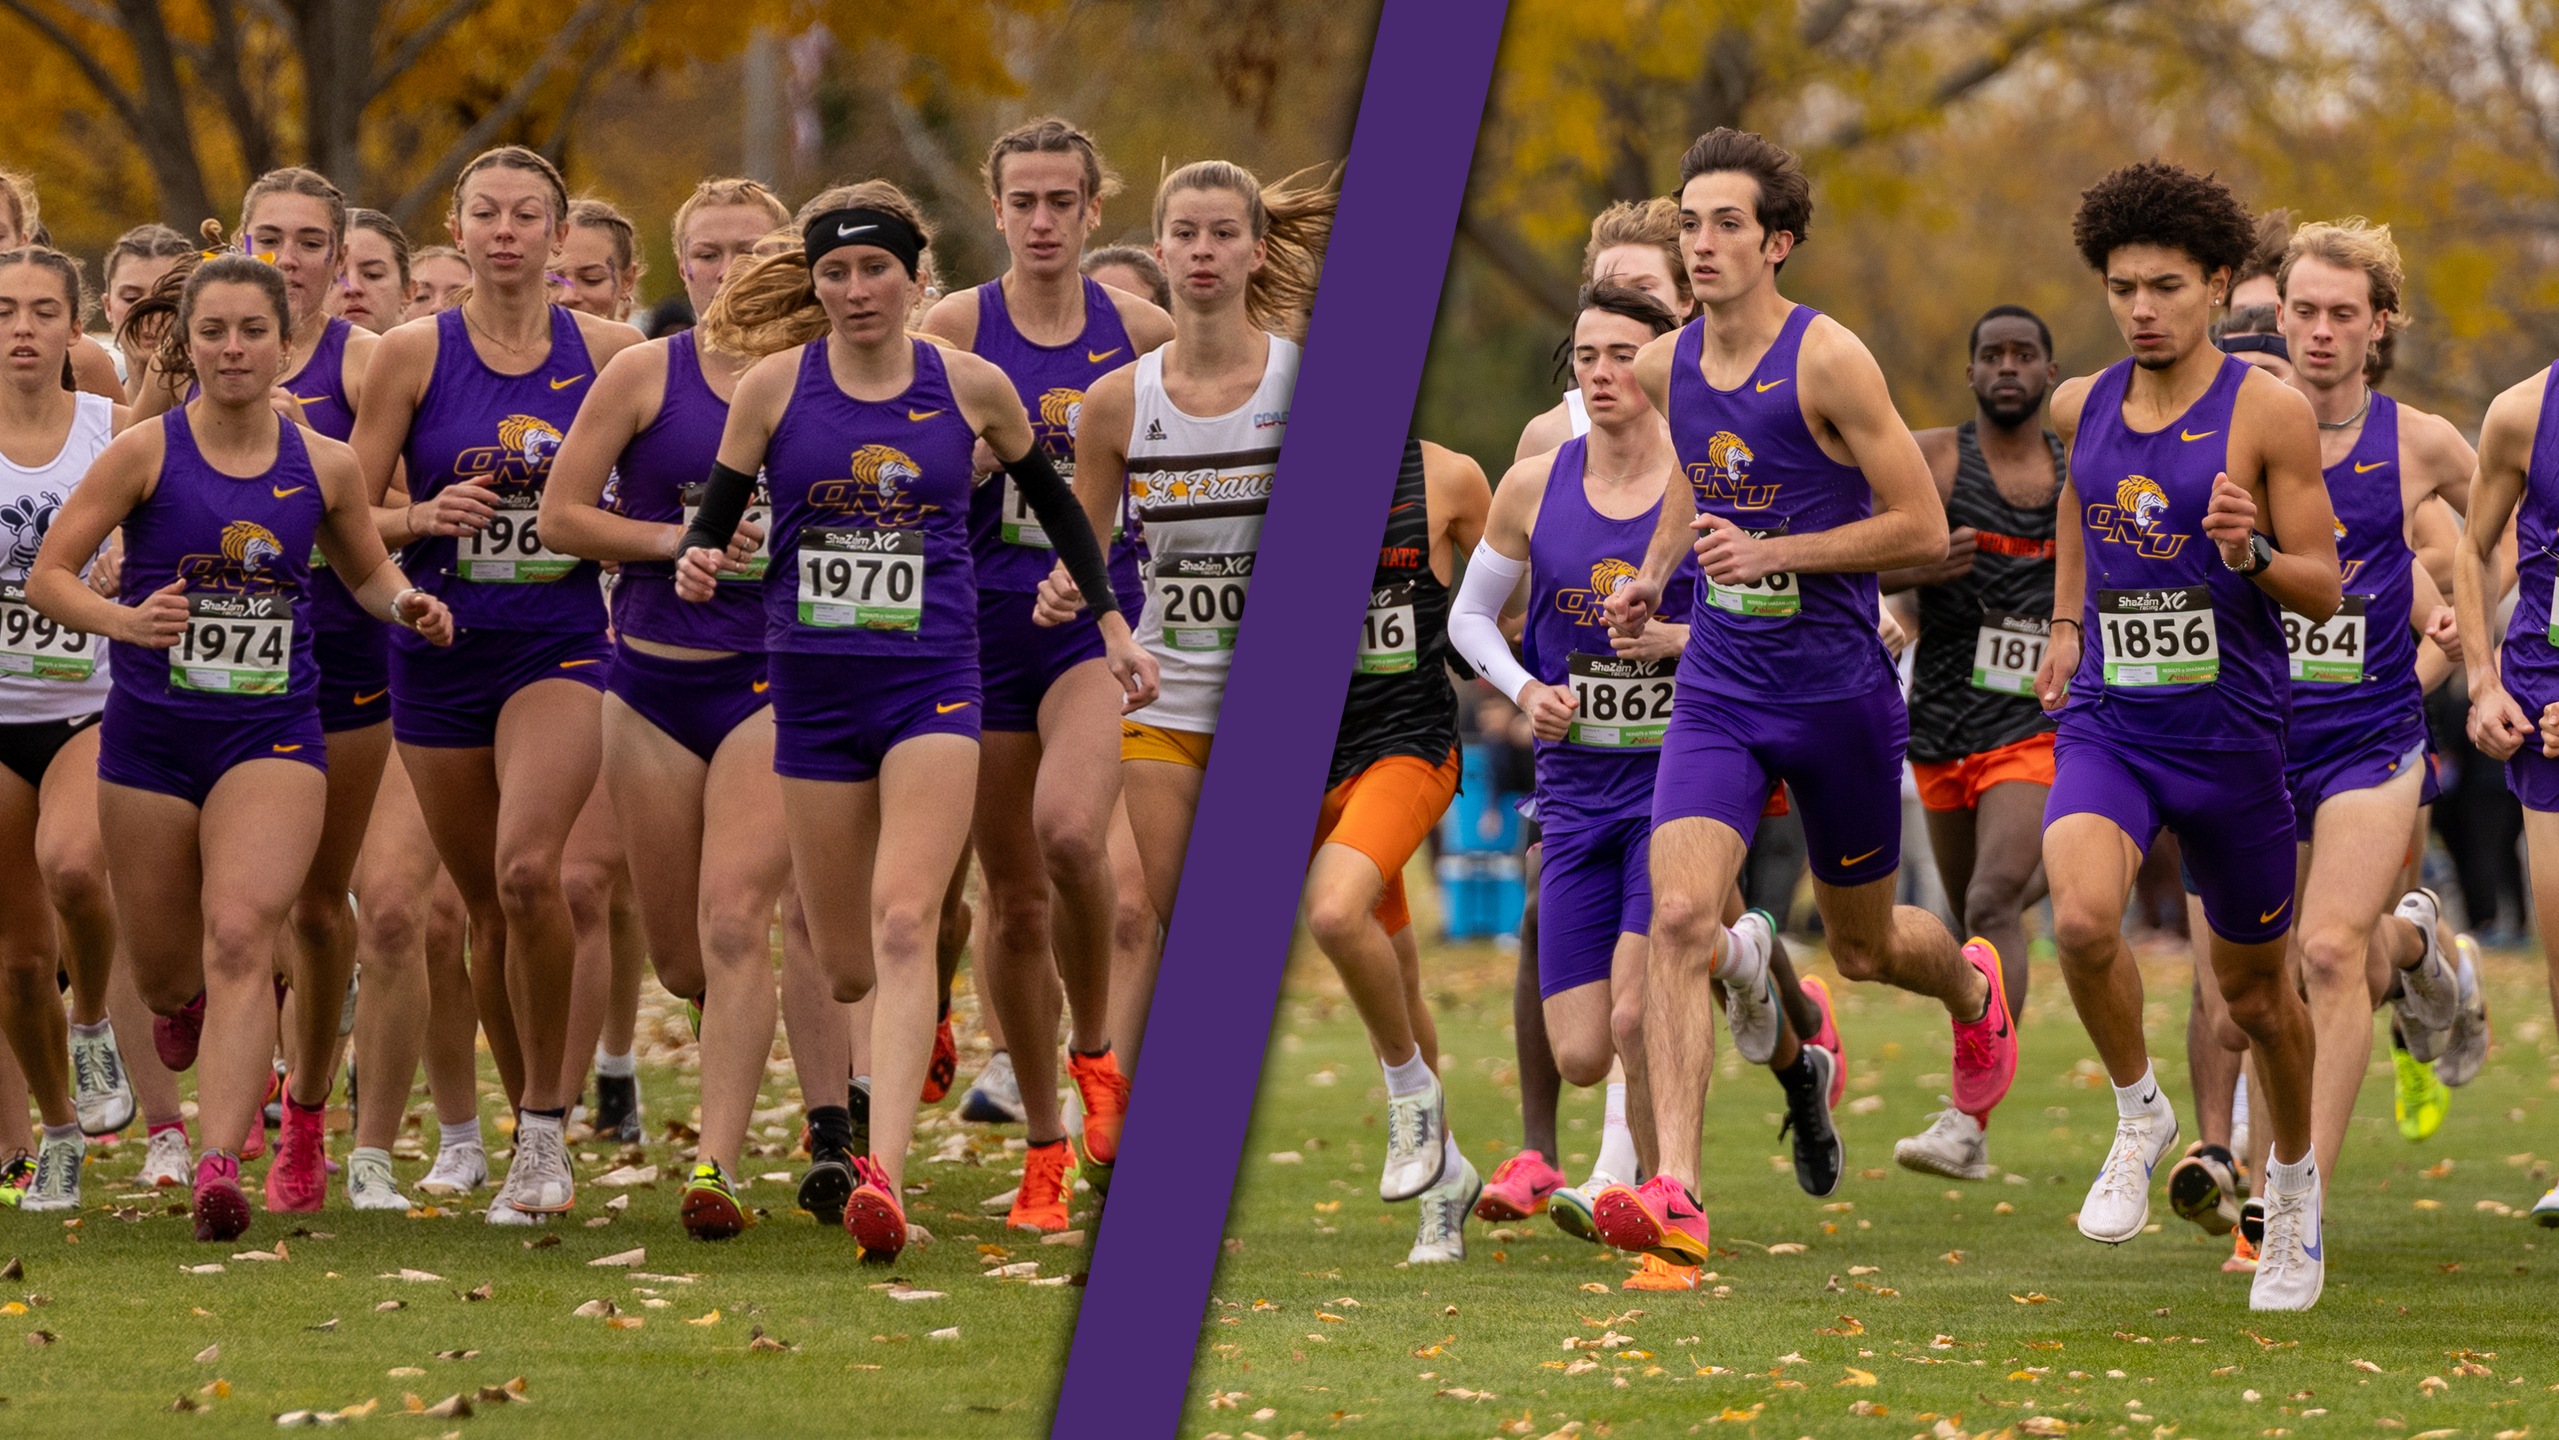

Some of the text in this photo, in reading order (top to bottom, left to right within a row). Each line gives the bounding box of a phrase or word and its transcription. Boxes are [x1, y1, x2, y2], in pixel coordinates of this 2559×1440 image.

[807, 479, 941, 527] ONU
[1144, 469, 1176, 509] St.
[1686, 463, 1783, 511] ONU
[868, 531, 900, 551] XC
[2087, 503, 2192, 560] ONU
[806, 557, 915, 603] 1970
[1221, 555, 1252, 576] XC
[242, 597, 273, 618] XC
[1161, 584, 1246, 623] 200
[2117, 590, 2188, 611] ShaZam XC
[182, 622, 284, 666] 1974
[2106, 615, 2210, 659] 1856
[1590, 660, 1632, 673] ShaZam
[1576, 682, 1674, 721] 1862
